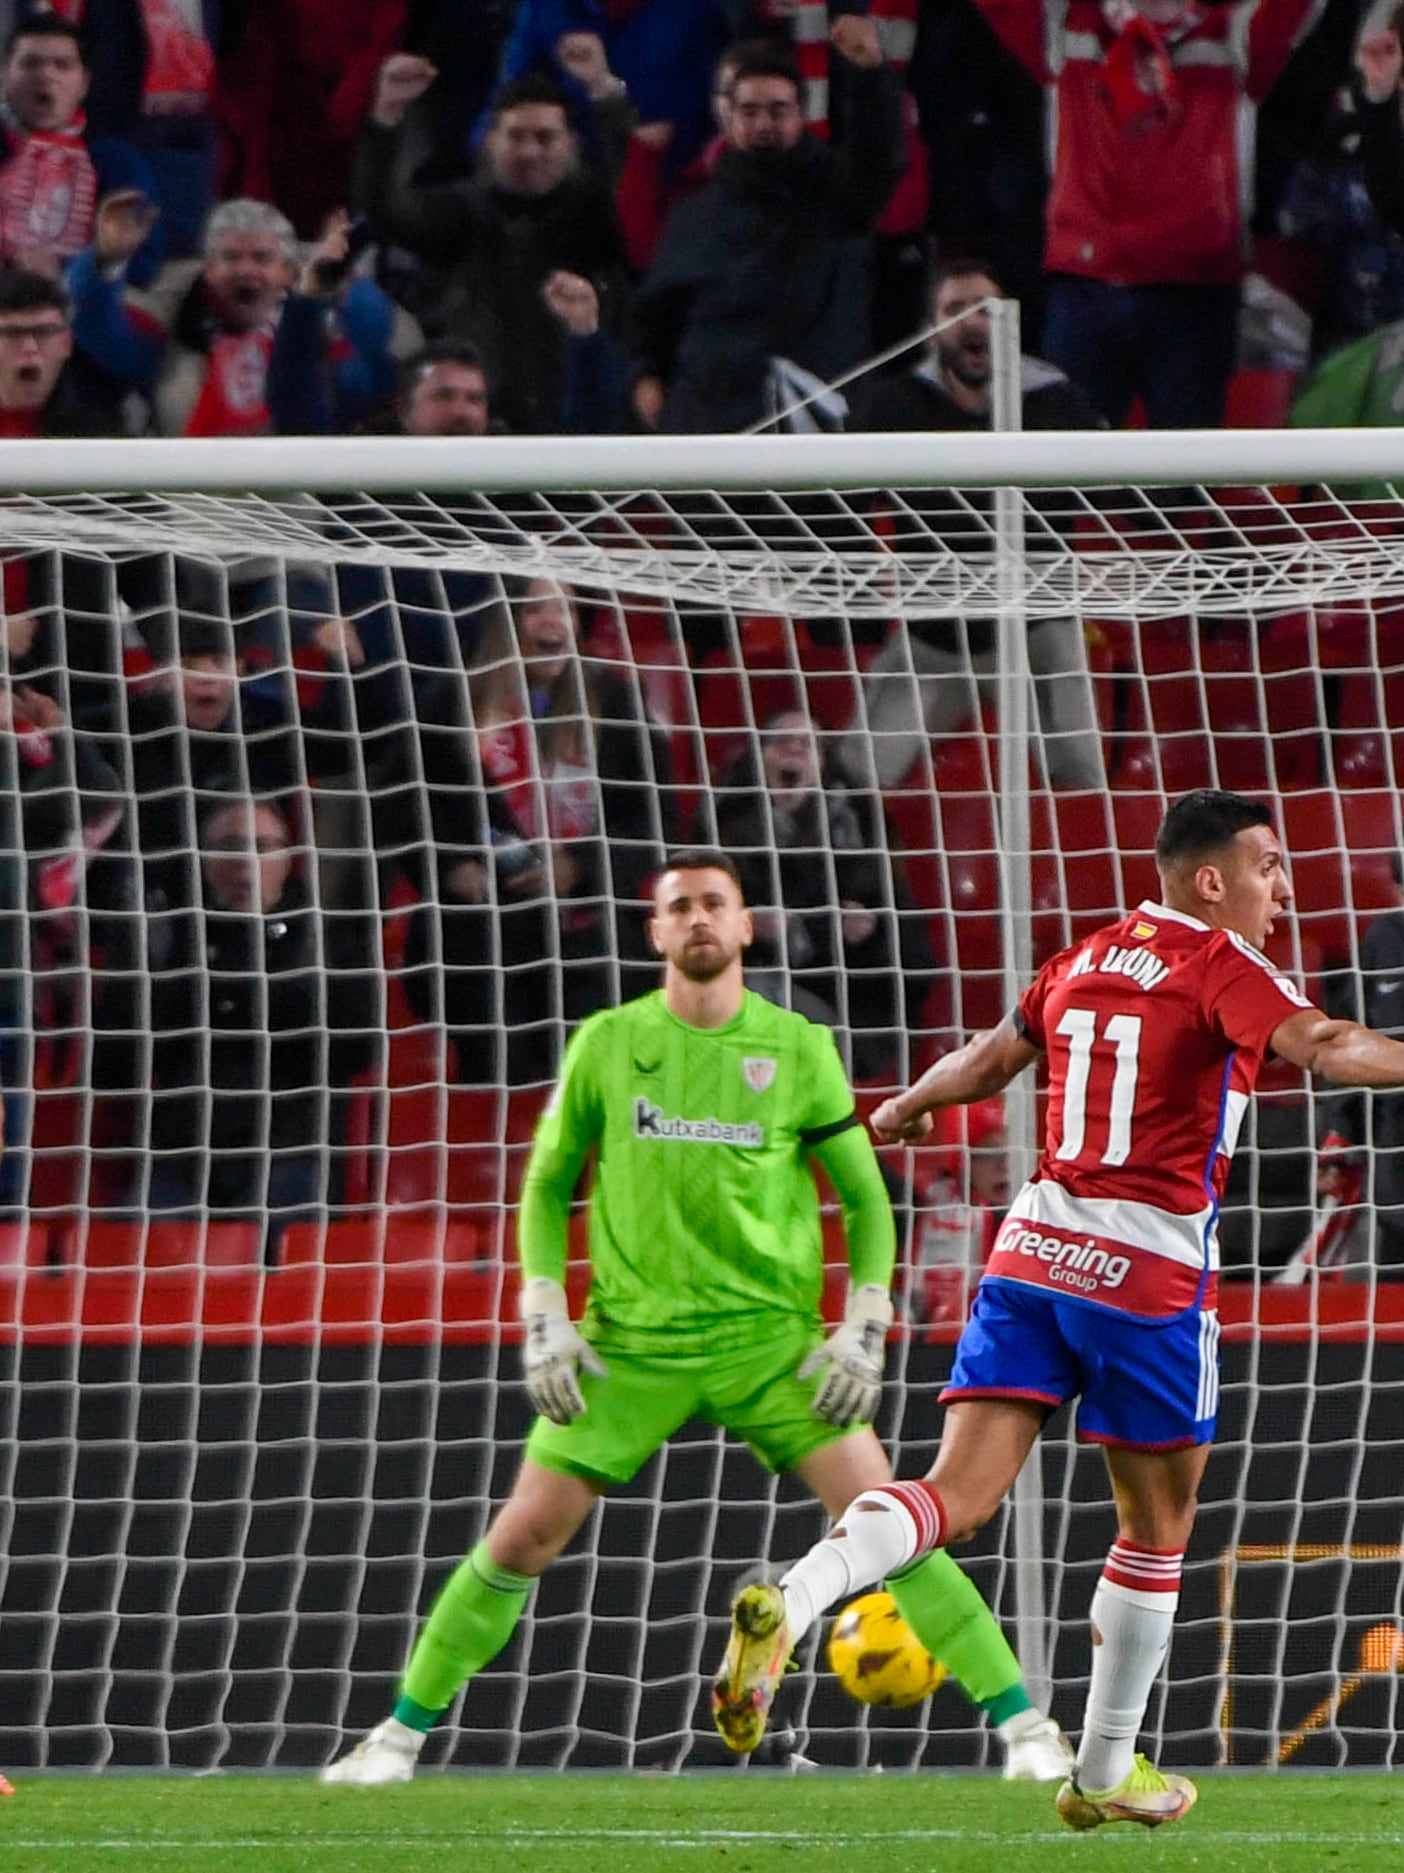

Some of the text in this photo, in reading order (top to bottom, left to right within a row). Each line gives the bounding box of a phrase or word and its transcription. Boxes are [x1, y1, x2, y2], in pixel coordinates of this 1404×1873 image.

[1055, 1008, 1142, 1167] 11
[995, 1222, 1132, 1288] Greening
[1049, 1265, 1098, 1292] Group
